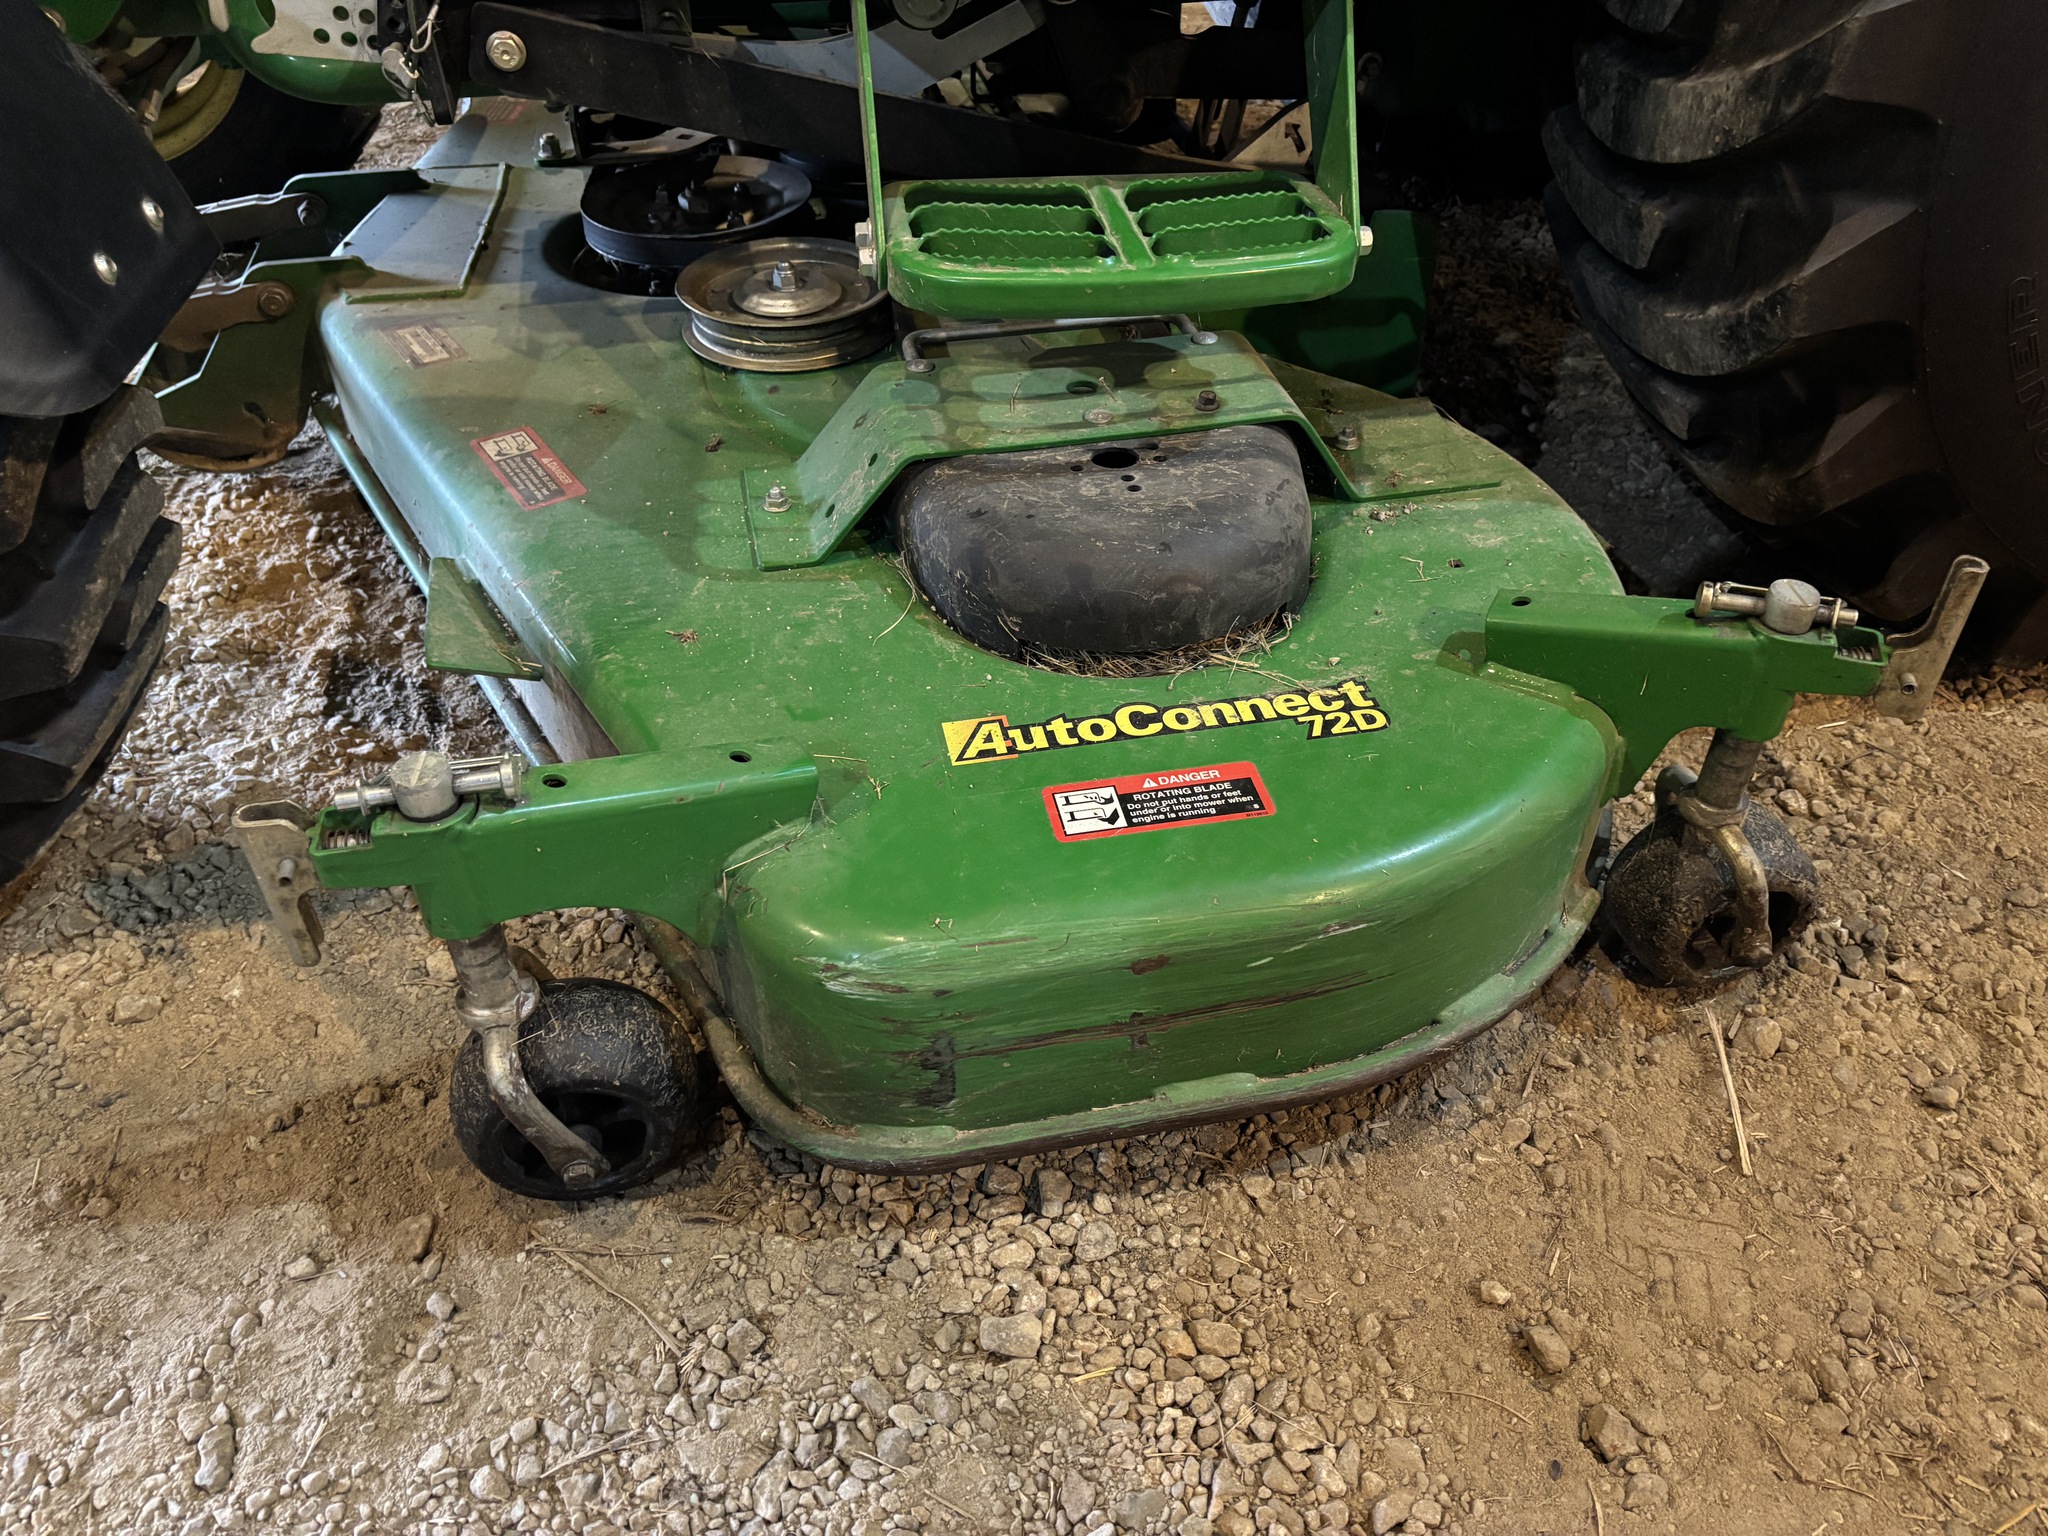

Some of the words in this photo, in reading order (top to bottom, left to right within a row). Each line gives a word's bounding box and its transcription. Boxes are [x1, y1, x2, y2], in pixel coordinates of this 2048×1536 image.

[548, 460, 572, 484] DANGER
[961, 680, 1375, 759] AutoConnect
[1297, 708, 1387, 737] 72D
[1158, 769, 1221, 786] DANGER
[1127, 802, 1140, 810] Do
[1143, 800, 1160, 808] not
[1162, 797, 1178, 807] put
[1180, 793, 1209, 804] hands
[1223, 789, 1241, 798] feet
[1133, 788, 1192, 801] ROTATING
[1194, 782, 1232, 794] BLADE
[1130, 807, 1158, 816] under
[1173, 802, 1192, 811] into
[1194, 799, 1226, 809] mower
[1226, 795, 1254, 804] when
[1131, 813, 1165, 823] engine
[1167, 810, 1176, 819] is
[1178, 807, 1216, 817] running
